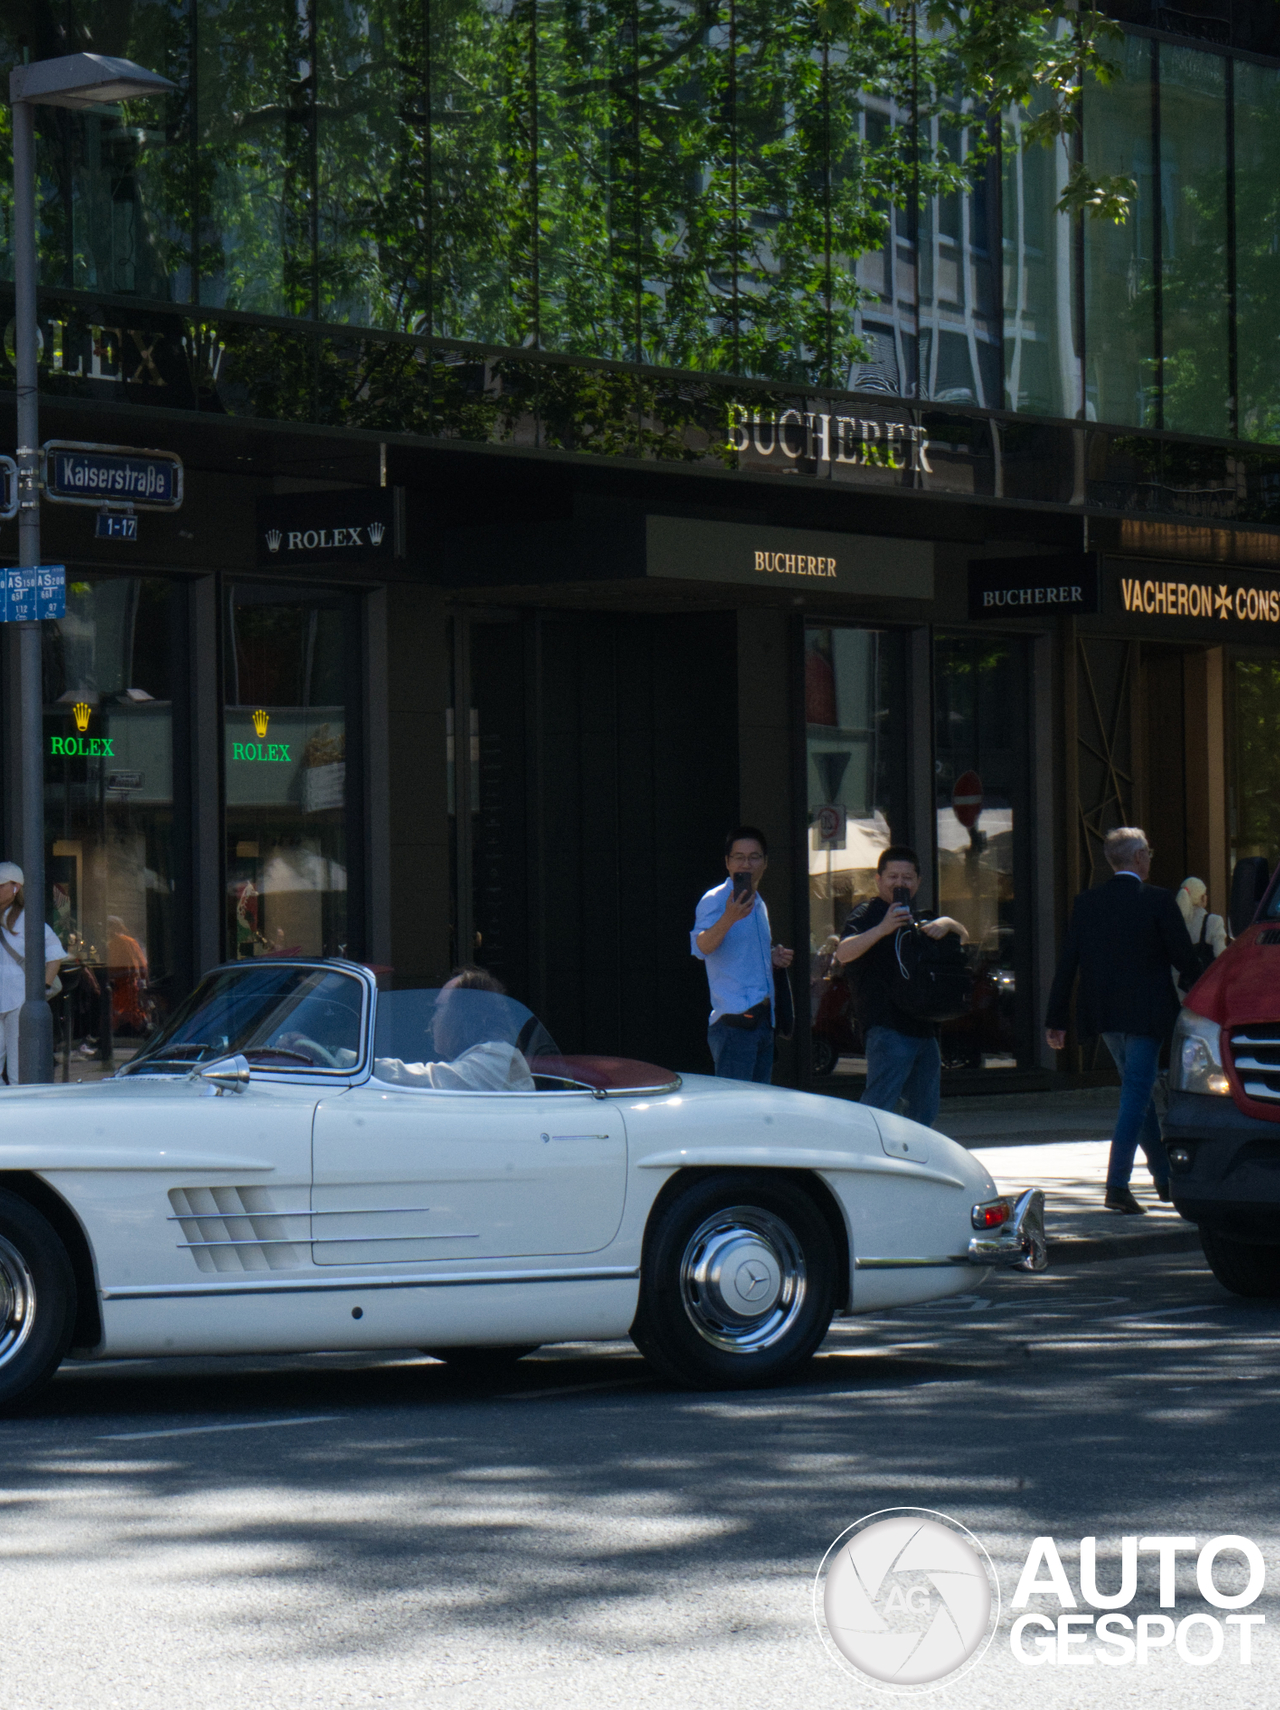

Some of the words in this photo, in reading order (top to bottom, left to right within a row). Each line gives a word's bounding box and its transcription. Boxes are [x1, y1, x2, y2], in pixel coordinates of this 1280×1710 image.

[728, 402, 933, 474] BUCHERER
[63, 457, 165, 497] Kaiserstraße
[107, 517, 136, 537] 1-17
[287, 527, 363, 549] ROLEX
[754, 551, 837, 578] BUCHERER
[983, 585, 1083, 607] BUCHERER
[1122, 578, 1213, 617] VACHERON
[1235, 587, 1280, 622] CONS
[50, 736, 115, 757] ROLEX
[232, 742, 292, 762] ROLEX
